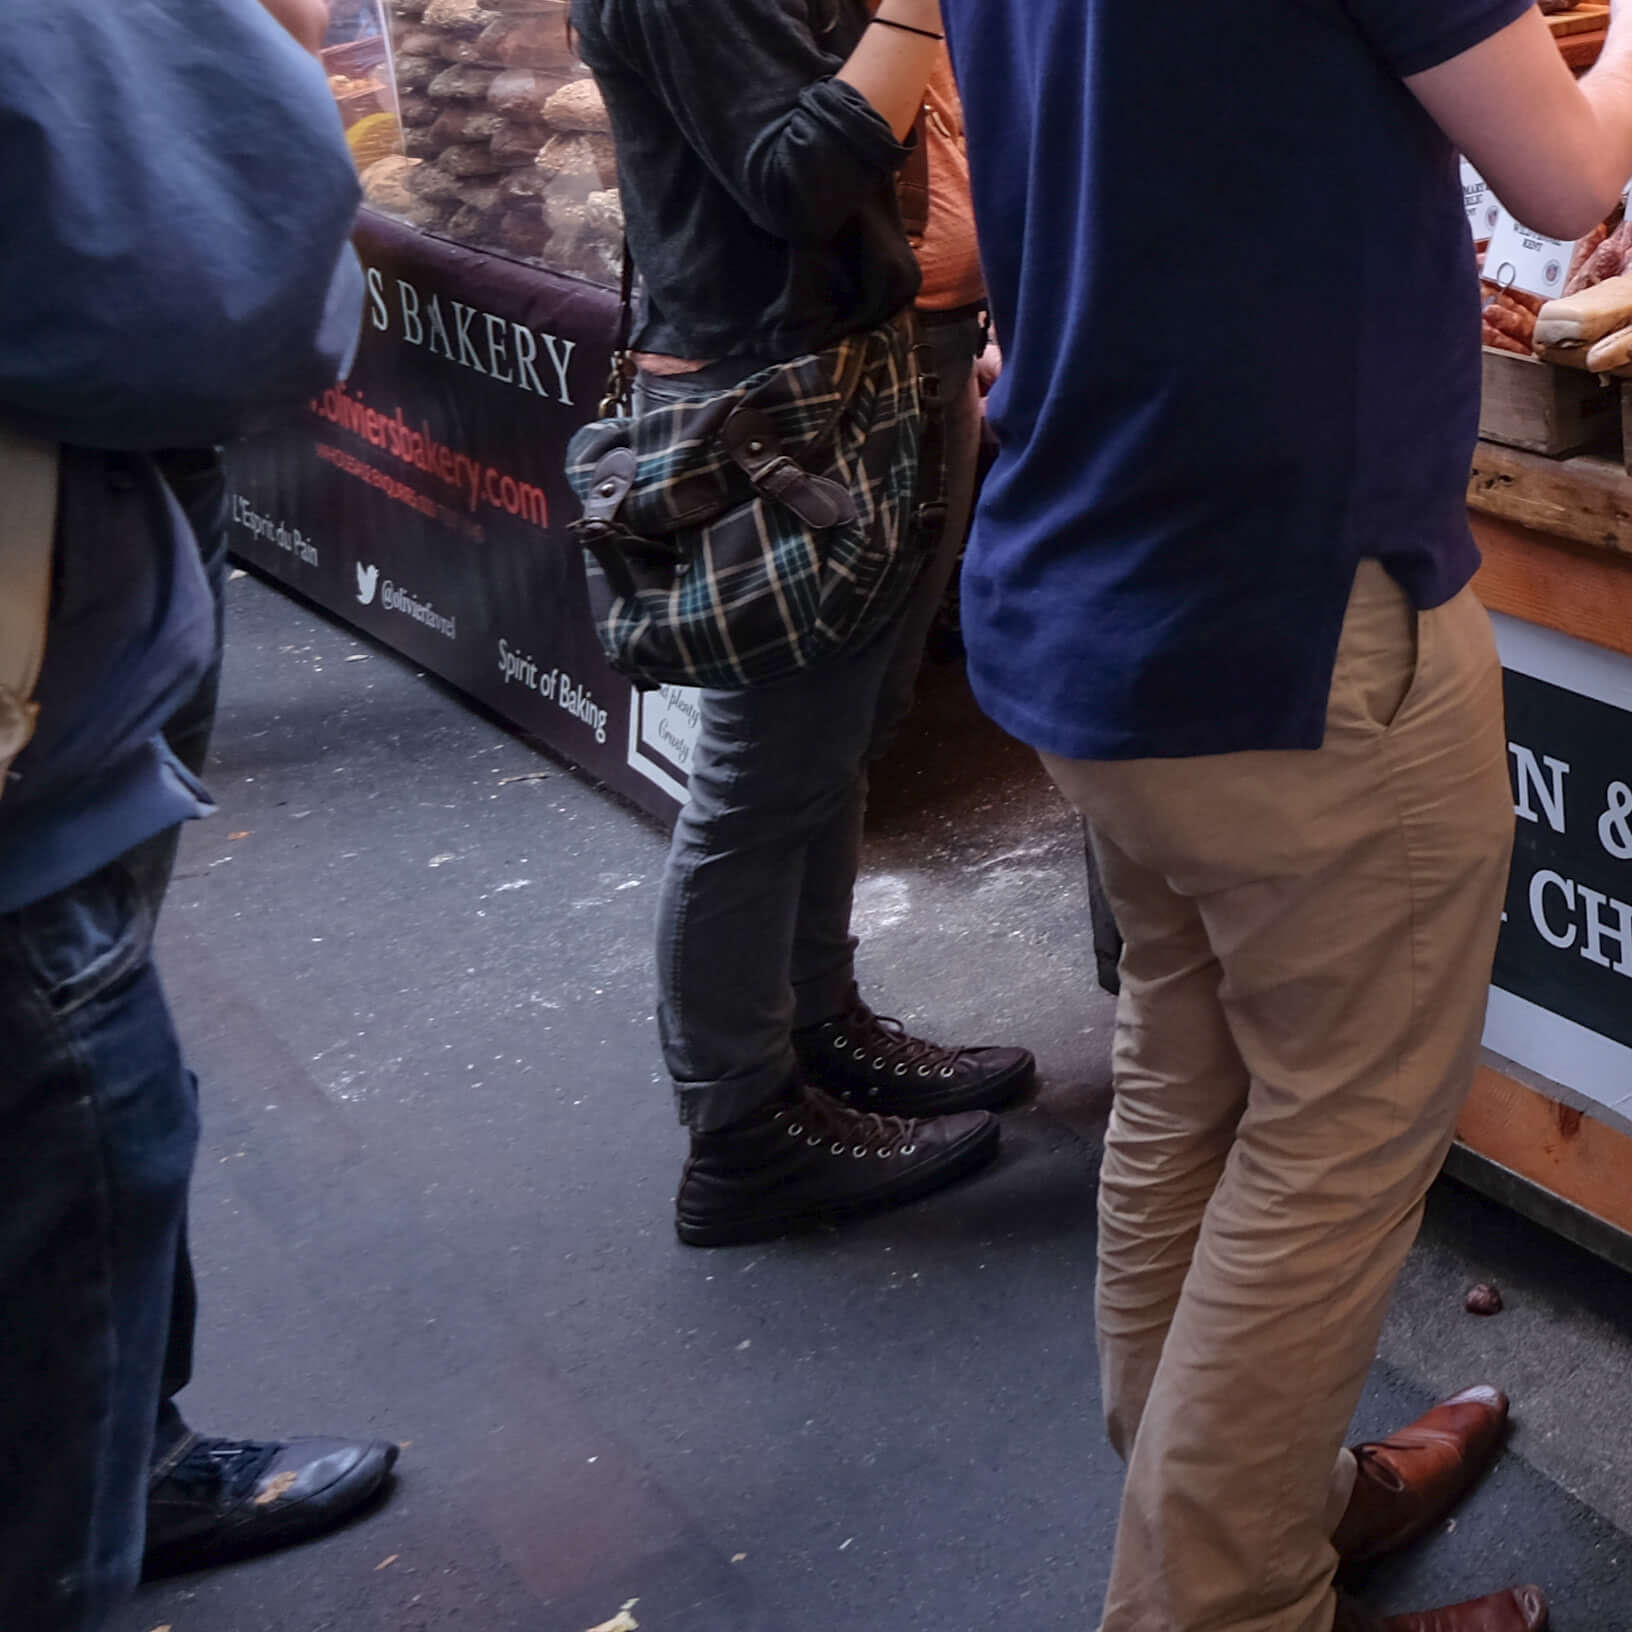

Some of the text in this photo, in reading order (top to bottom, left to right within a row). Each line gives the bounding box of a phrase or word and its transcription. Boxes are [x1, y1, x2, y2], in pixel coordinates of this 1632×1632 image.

[1522, 238, 1544, 252] KENT
[397, 278, 577, 407] BAKERY
[275, 521, 292, 551] du
[293, 528, 319, 567] Pain
[498, 637, 608, 744] Spirit of Baking
